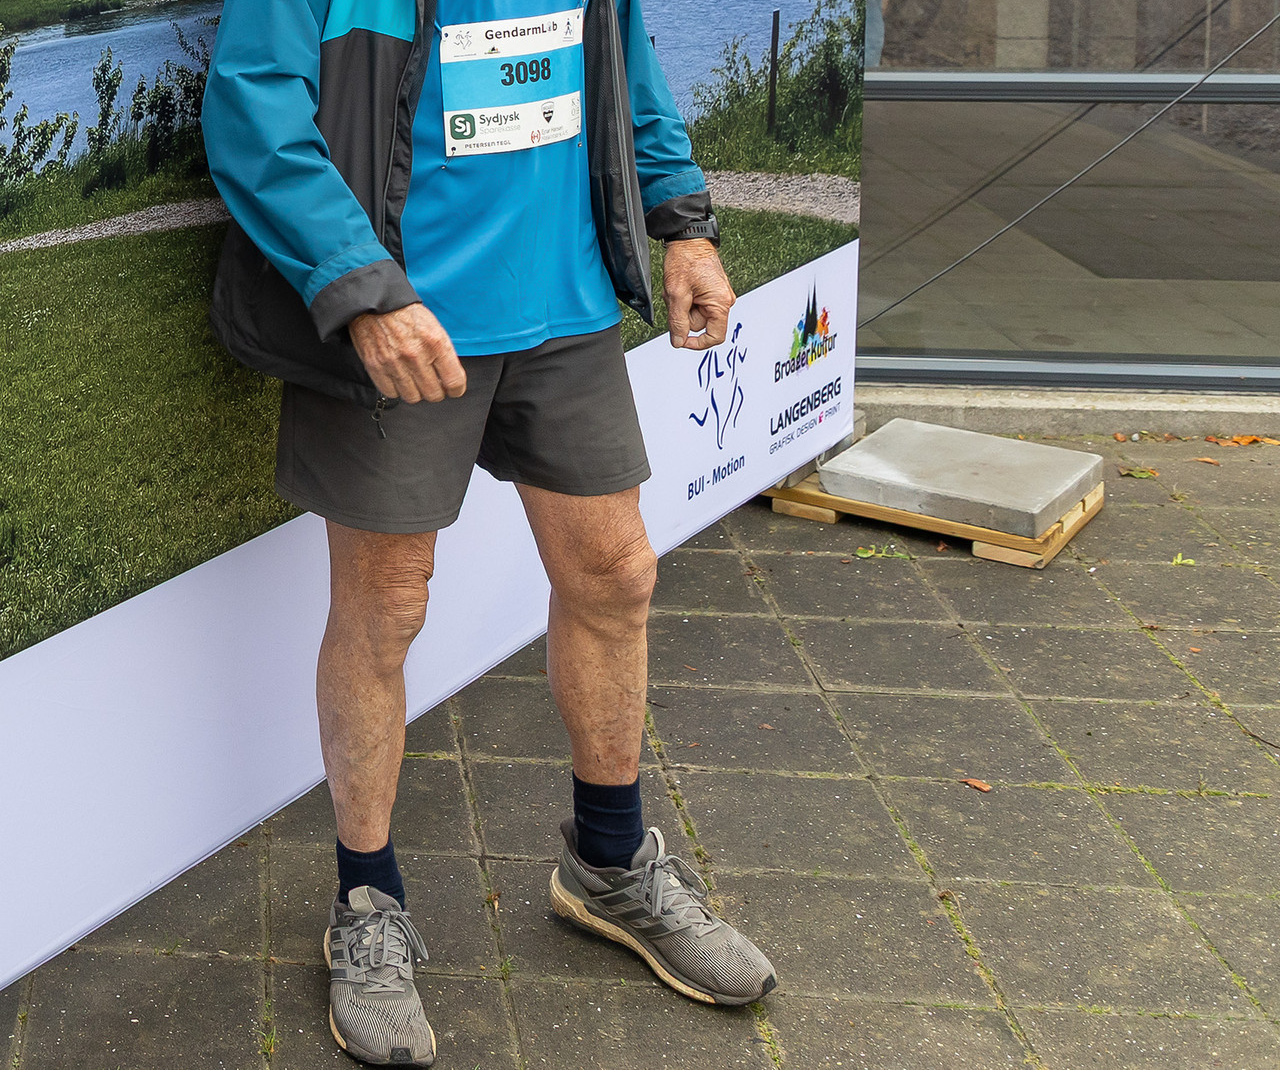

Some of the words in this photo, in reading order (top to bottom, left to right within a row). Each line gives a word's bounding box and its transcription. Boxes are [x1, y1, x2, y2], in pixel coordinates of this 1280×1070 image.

[500, 57, 552, 87] 3098
[769, 431, 795, 455] GRAFISK
[796, 416, 818, 438] DESIGN
[824, 402, 841, 420] PRINT
[770, 377, 841, 436] LANGENBERG
[687, 476, 705, 501] BUI
[712, 455, 745, 487] Motion
